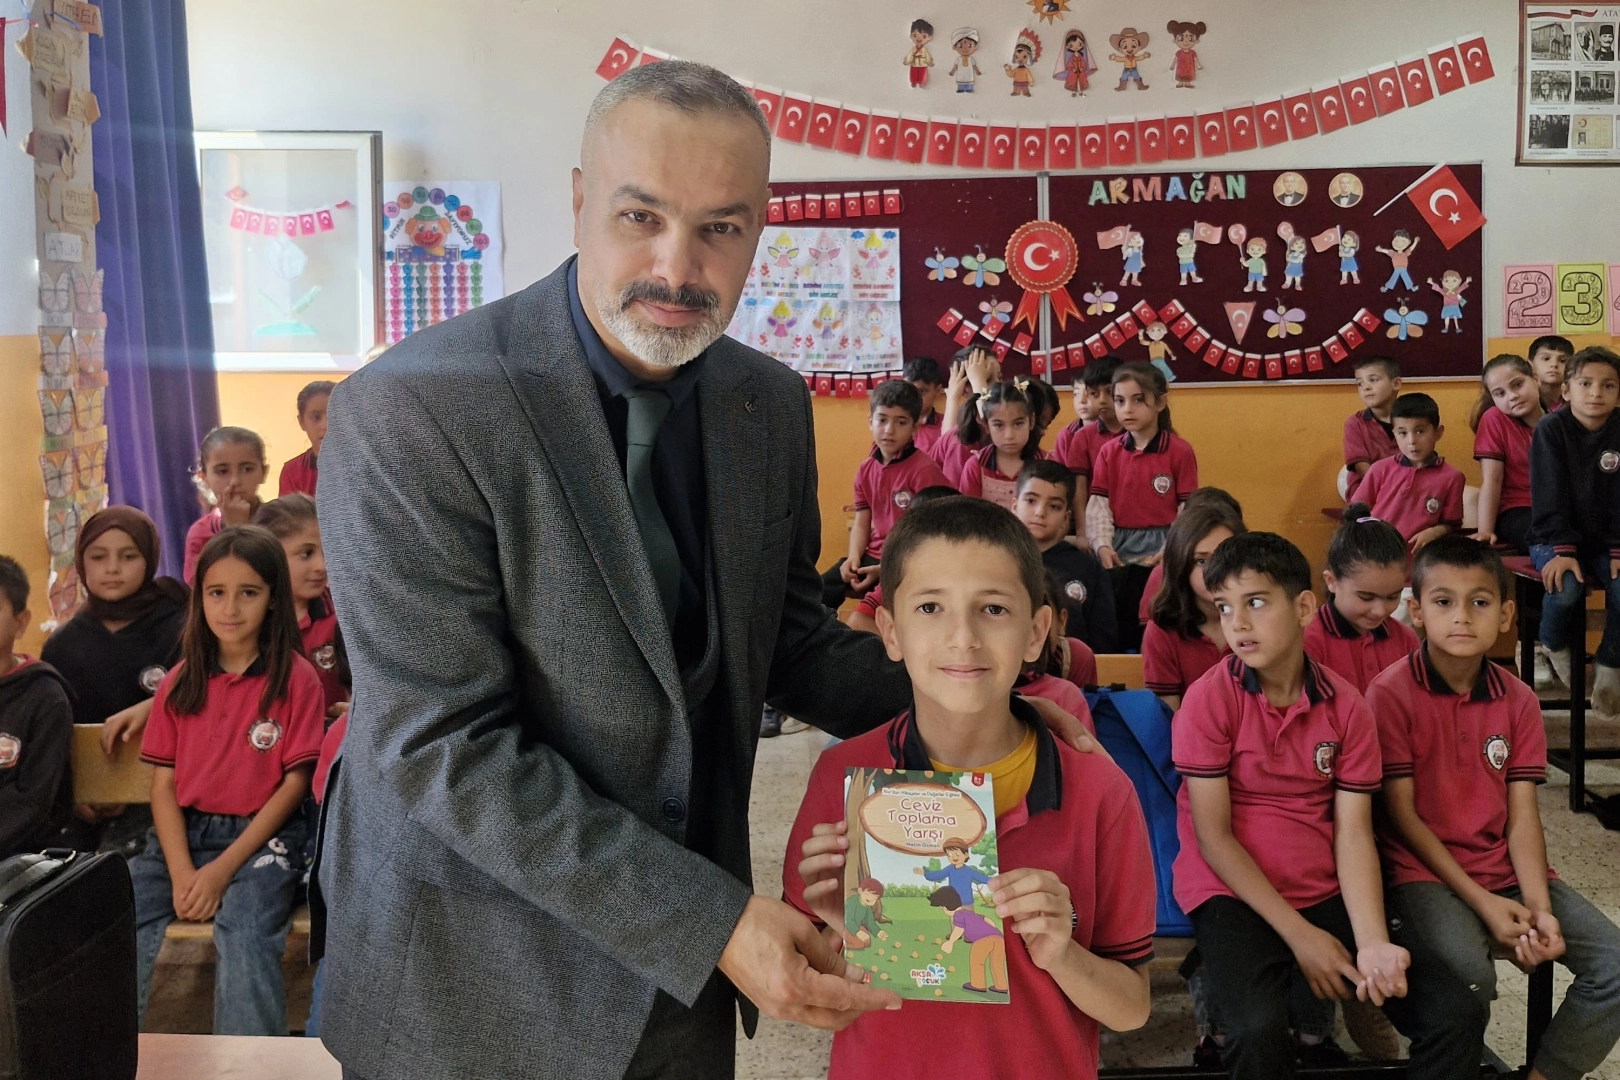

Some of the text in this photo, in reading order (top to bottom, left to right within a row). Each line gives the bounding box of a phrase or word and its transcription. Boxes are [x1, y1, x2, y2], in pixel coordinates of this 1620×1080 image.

[1088, 172, 1246, 206] ARMAĞAN
[1507, 270, 1552, 329] 2
[1561, 271, 1604, 326] 3
[901, 798, 942, 811] Ceviz
[888, 809, 956, 825] Toplama
[904, 825, 943, 842] Yarışı
[911, 970, 931, 978] AKSA
